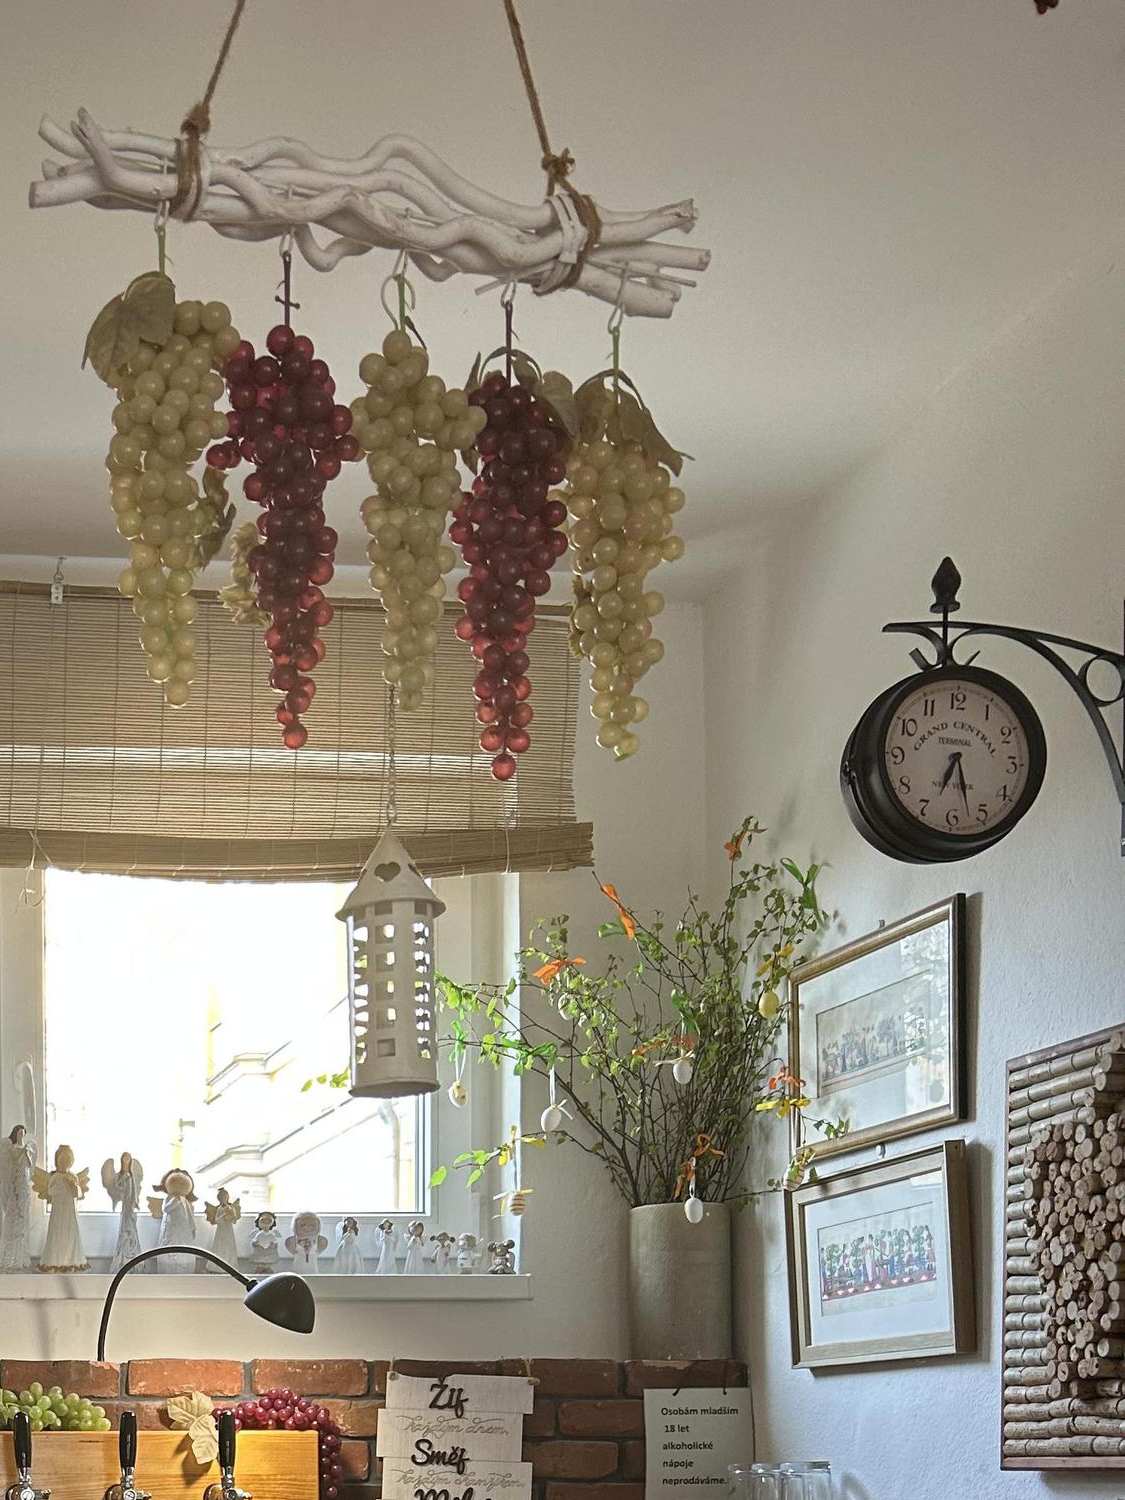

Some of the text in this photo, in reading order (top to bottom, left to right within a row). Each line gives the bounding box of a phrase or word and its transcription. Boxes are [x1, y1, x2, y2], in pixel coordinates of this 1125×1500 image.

[924, 699, 935, 717] 11
[950, 692, 967, 711] 12
[985, 704, 990, 721] 1
[900, 718, 918, 737] 10
[1000, 725, 1012, 744] 2
[914, 721, 996, 758] GRAND CENTRAL
[938, 736, 972, 747] TERMINAL
[891, 746, 905, 765] 9
[1005, 756, 1017, 774] 3
[899, 775, 911, 795] 8
[995, 784, 1009, 801] 4
[918, 798, 930, 817] 7
[976, 803, 988, 823] 5
[945, 808, 959, 827] 6
[429, 1376, 469, 1418] Žij
[660, 1406, 739, 1416] Osobám mladším
[677, 1424, 690, 1432] let
[662, 1441, 713, 1450] alkoholické
[411, 1438, 470, 1475] Směj
[662, 1459, 694, 1469] nápoje
[662, 1476, 728, 1485] neprodáváme.
